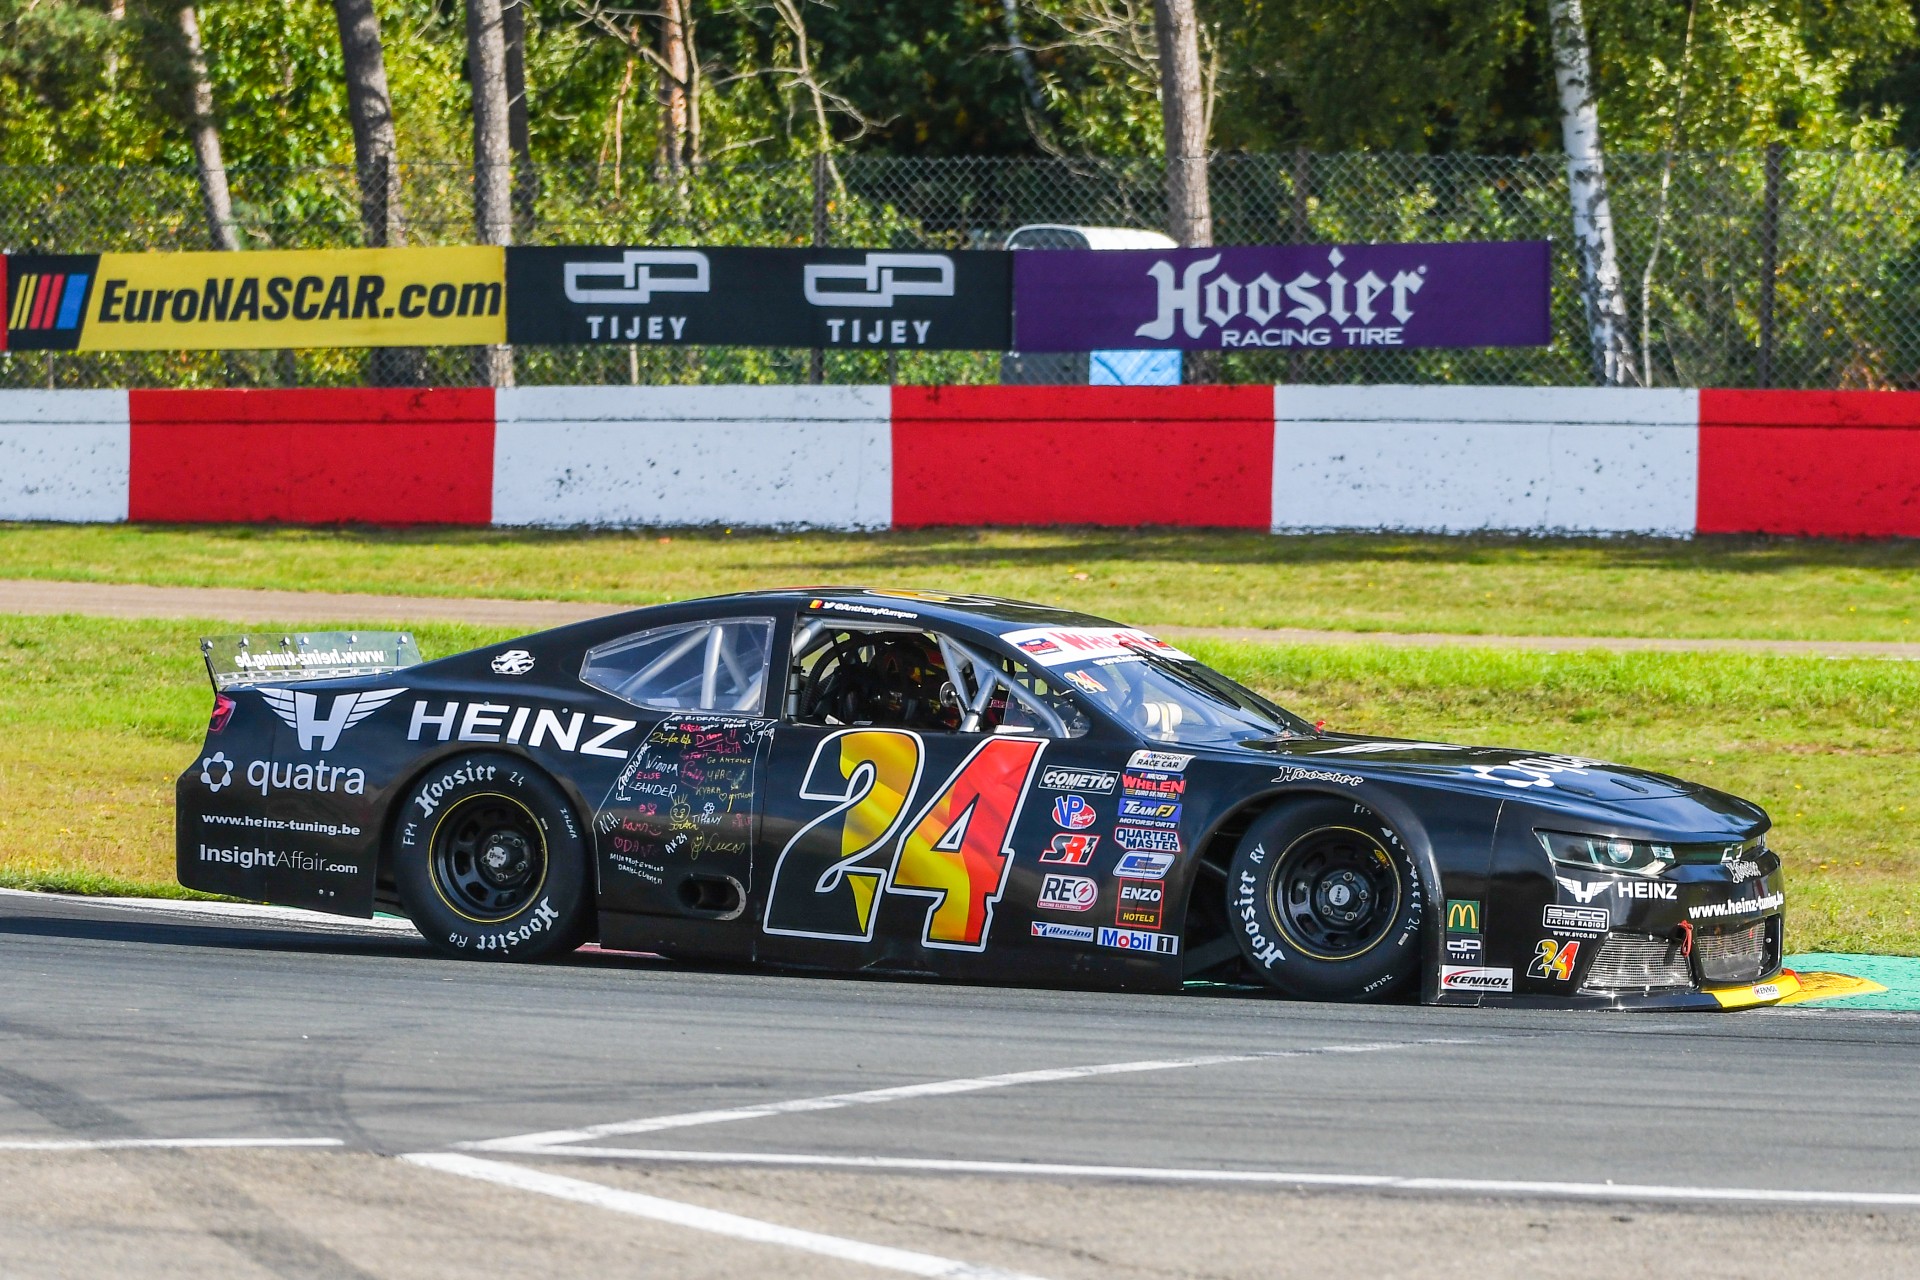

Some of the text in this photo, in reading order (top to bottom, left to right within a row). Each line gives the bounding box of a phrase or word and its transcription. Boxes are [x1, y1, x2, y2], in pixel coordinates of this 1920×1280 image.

[99, 275, 500, 324] EuroNASCAR.com
[1134, 247, 1426, 341] Hoosier
[586, 316, 687, 340] TIJEY
[827, 319, 932, 344] TIJEY
[1221, 326, 1404, 347] RACING TIRE
[407, 700, 637, 759] HEINZ
[1136, 759, 1159, 767] RACE
[247, 760, 365, 796] quatra
[1043, 771, 1115, 789] COMETIC
[1122, 774, 1186, 794] WHELEN
[1271, 765, 1364, 787] Hoosier
[415, 760, 497, 819] Hoosier
[1054, 795, 1086, 828] VP
[202, 814, 360, 836] www.heinz-tuning.be
[1118, 817, 1176, 829] MOTORSPORTS
[763, 728, 1049, 953] 24
[1116, 828, 1177, 842] QUARTER
[1126, 838, 1179, 851] MASTER
[200, 844, 358, 874] InsightAffair.com
[1120, 886, 1162, 902] ENZO
[1617, 881, 1678, 900] HEINZ
[476, 896, 559, 954] Hoosier
[1122, 912, 1155, 923] HOTELS
[1233, 869, 1286, 969] Hoosier
[1546, 918, 1606, 929] RACING RADIOS
[1048, 926, 1093, 938] iRacing
[1101, 929, 1152, 950] Mobil
[1552, 930, 1598, 939] WWW.SYCO.EU
[1451, 952, 1476, 960] TIJEY
[1526, 938, 1581, 981] 24
[1447, 975, 1510, 987] KENNOL
